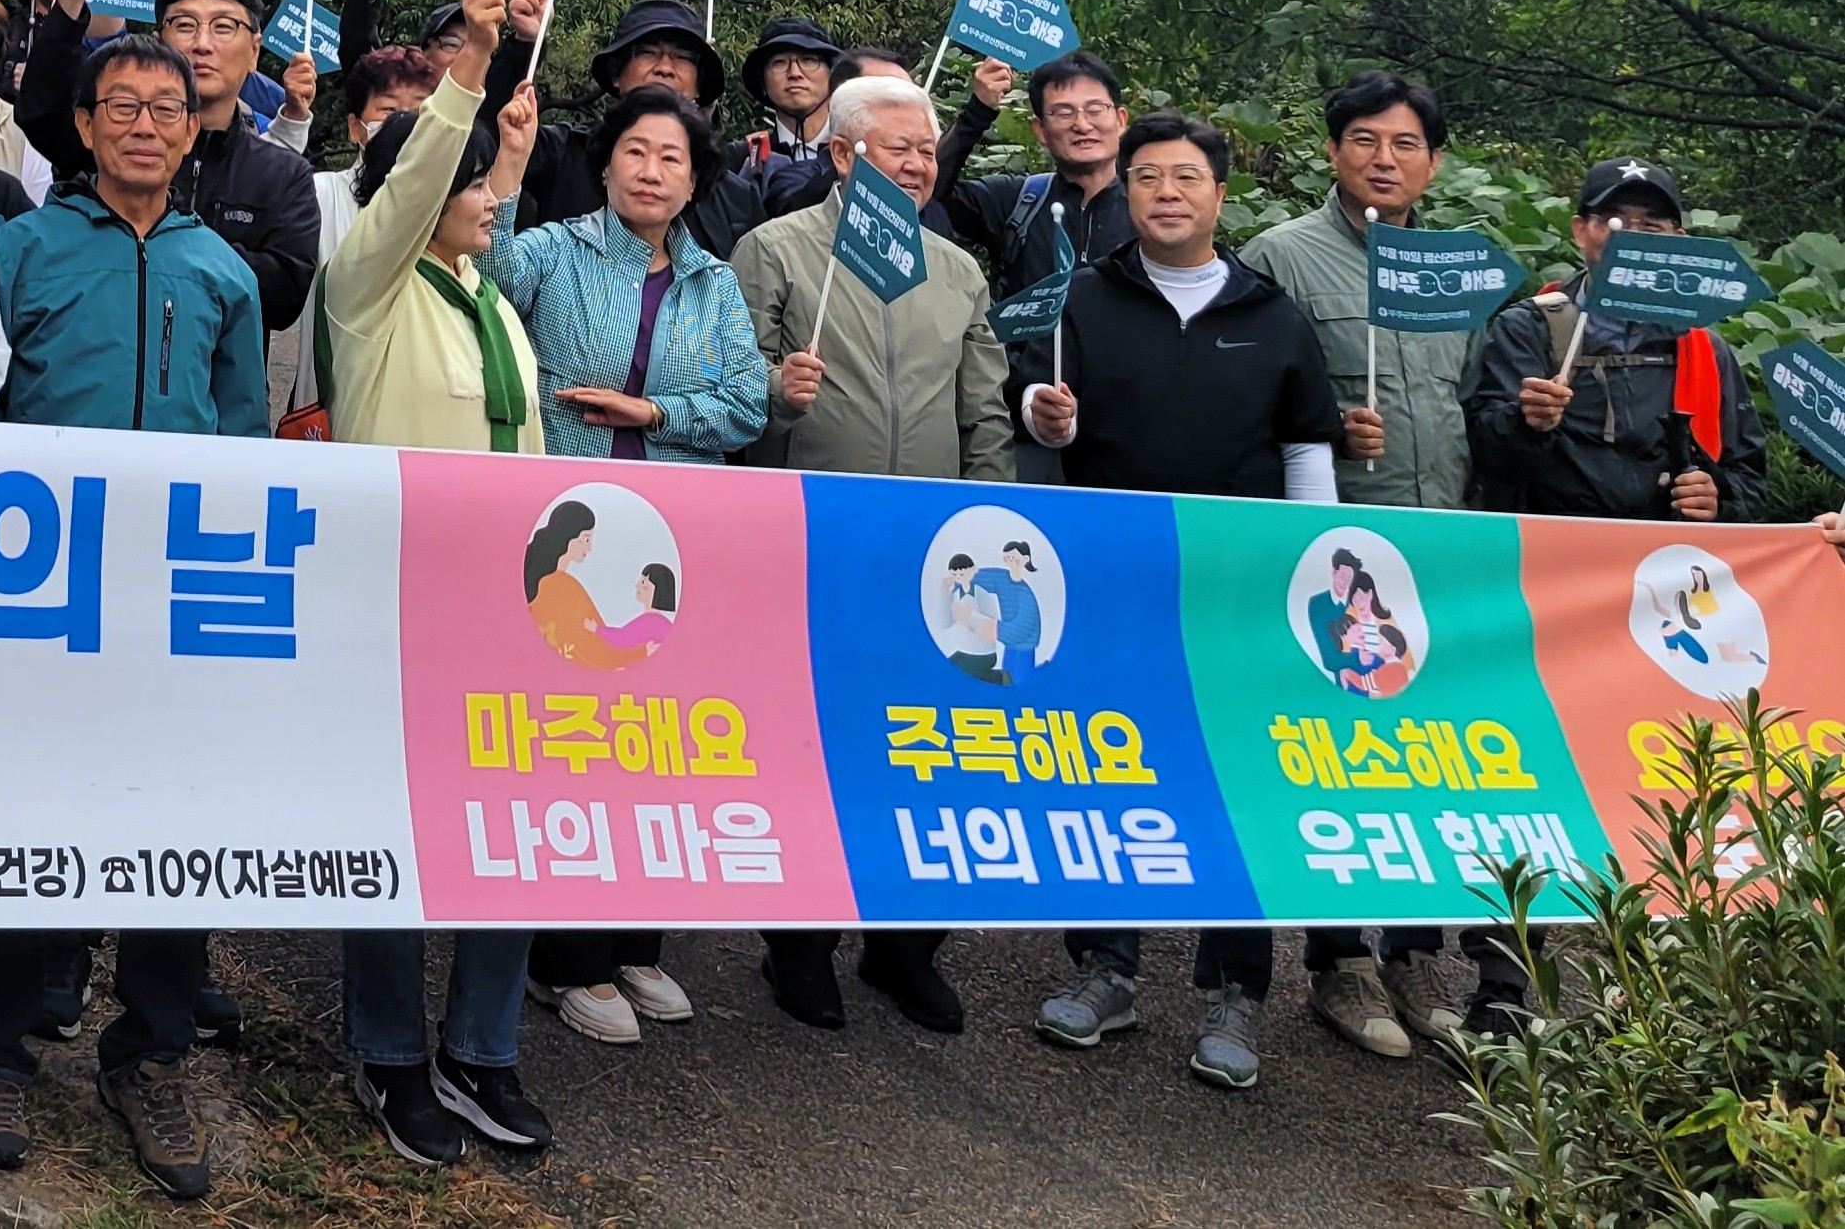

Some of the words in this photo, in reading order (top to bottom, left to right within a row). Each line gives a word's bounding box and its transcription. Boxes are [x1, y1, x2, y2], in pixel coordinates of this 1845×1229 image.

[1050, 4, 1060, 16] 날
[855, 180, 867, 200] 10월
[867, 191, 879, 210] 10일
[878, 200, 907, 233] 정신건강의
[905, 224, 914, 240] 날
[1377, 245, 1397, 260] 10월
[1398, 250, 1422, 263] 10일
[1423, 250, 1475, 264] 정신건강의
[1477, 249, 1488, 260] 날
[1793, 353, 1809, 371] 10월
[1809, 366, 1826, 384] 10일
[166, 481, 316, 660] 날
[464, 692, 757, 777] 마주해요
[885, 705, 1158, 786] 주목해요
[1268, 714, 1538, 790] 해소해요
[464, 799, 617, 882] 나의
[633, 801, 784, 884] 마음
[894, 806, 1040, 884] 너의
[1045, 807, 1196, 885] 마음
[1298, 810, 1436, 885] 우리
